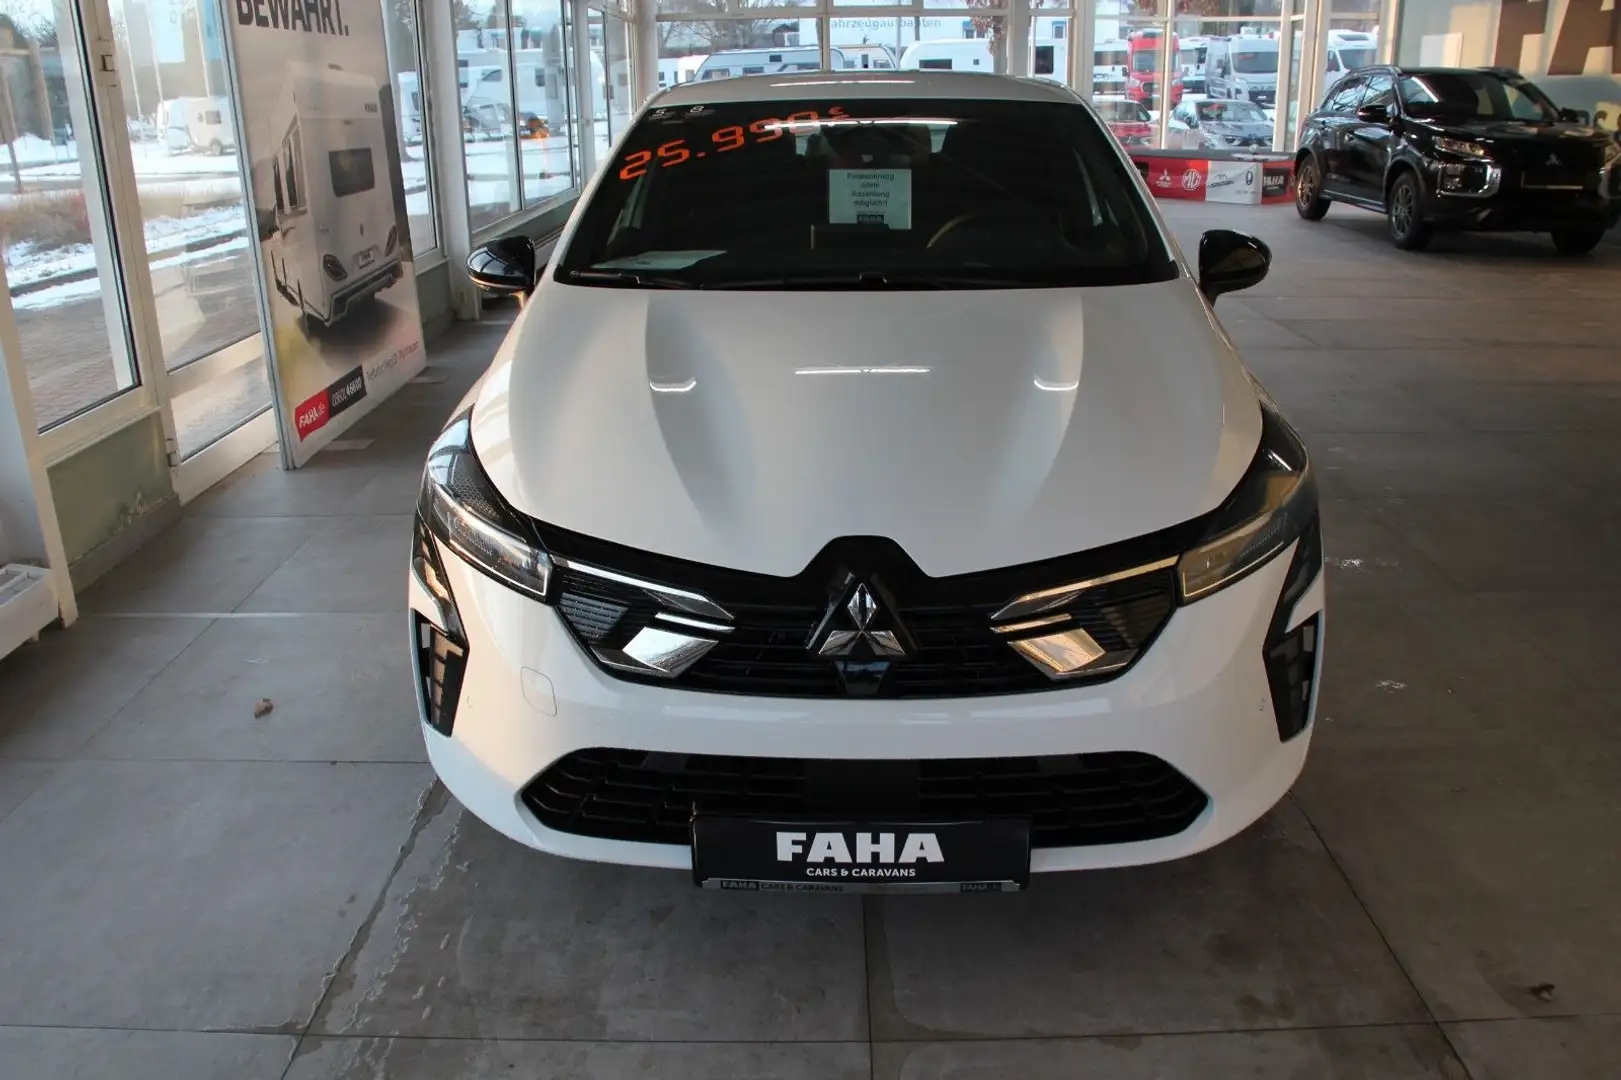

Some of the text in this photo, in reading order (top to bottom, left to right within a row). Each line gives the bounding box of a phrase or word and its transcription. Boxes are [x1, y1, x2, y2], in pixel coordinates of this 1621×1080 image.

[776, 831, 945, 863] FAHA
[806, 868, 916, 877] CARS & CARAVANS
